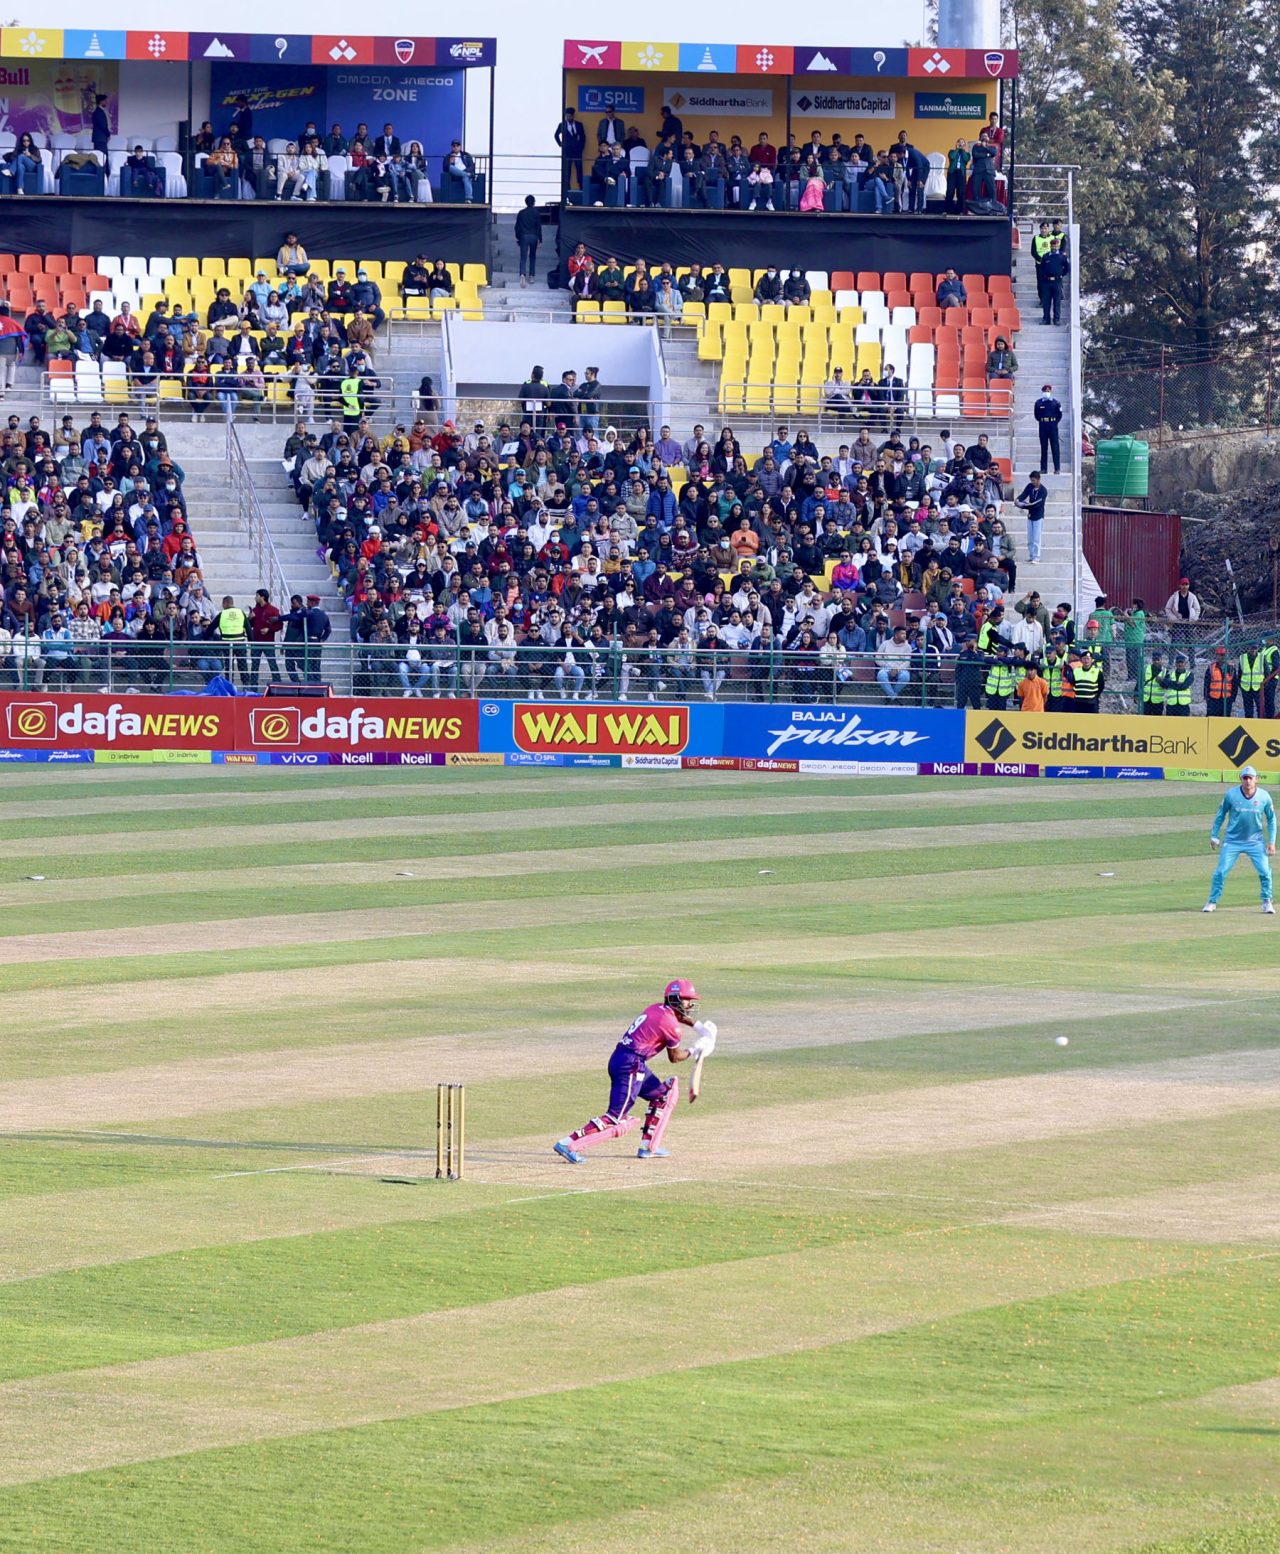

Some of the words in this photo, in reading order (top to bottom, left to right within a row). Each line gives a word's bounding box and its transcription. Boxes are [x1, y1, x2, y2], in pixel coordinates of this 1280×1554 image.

[0, 67, 29, 85] Bull
[223, 86, 315, 104] NXT-GEN
[373, 89, 417, 101] ZONE
[605, 91, 637, 104] SPIL
[689, 97, 768, 108] SiddharthaBank
[814, 96, 860, 111] Siddhartha
[861, 97, 890, 113] Capital
[58, 703, 219, 742] dafaNEWS
[792, 711, 845, 722] BAJAJ
[301, 707, 462, 745] dafaNEWS
[521, 711, 597, 745] WAI
[604, 713, 679, 747] WAI
[767, 714, 930, 756] pulsar
[1022, 731, 1197, 756] SiddharthaBank
[226, 755, 240, 763] WAI
[241, 755, 255, 763] WAI
[282, 754, 317, 763] vivo
[342, 753, 373, 764] Ncell
[401, 753, 431, 764] Ncell
[635, 756, 661, 765] Siddhartha
[662, 757, 678, 766] Capital
[934, 763, 964, 774] Ncell
[995, 763, 1025, 774] Ncell
